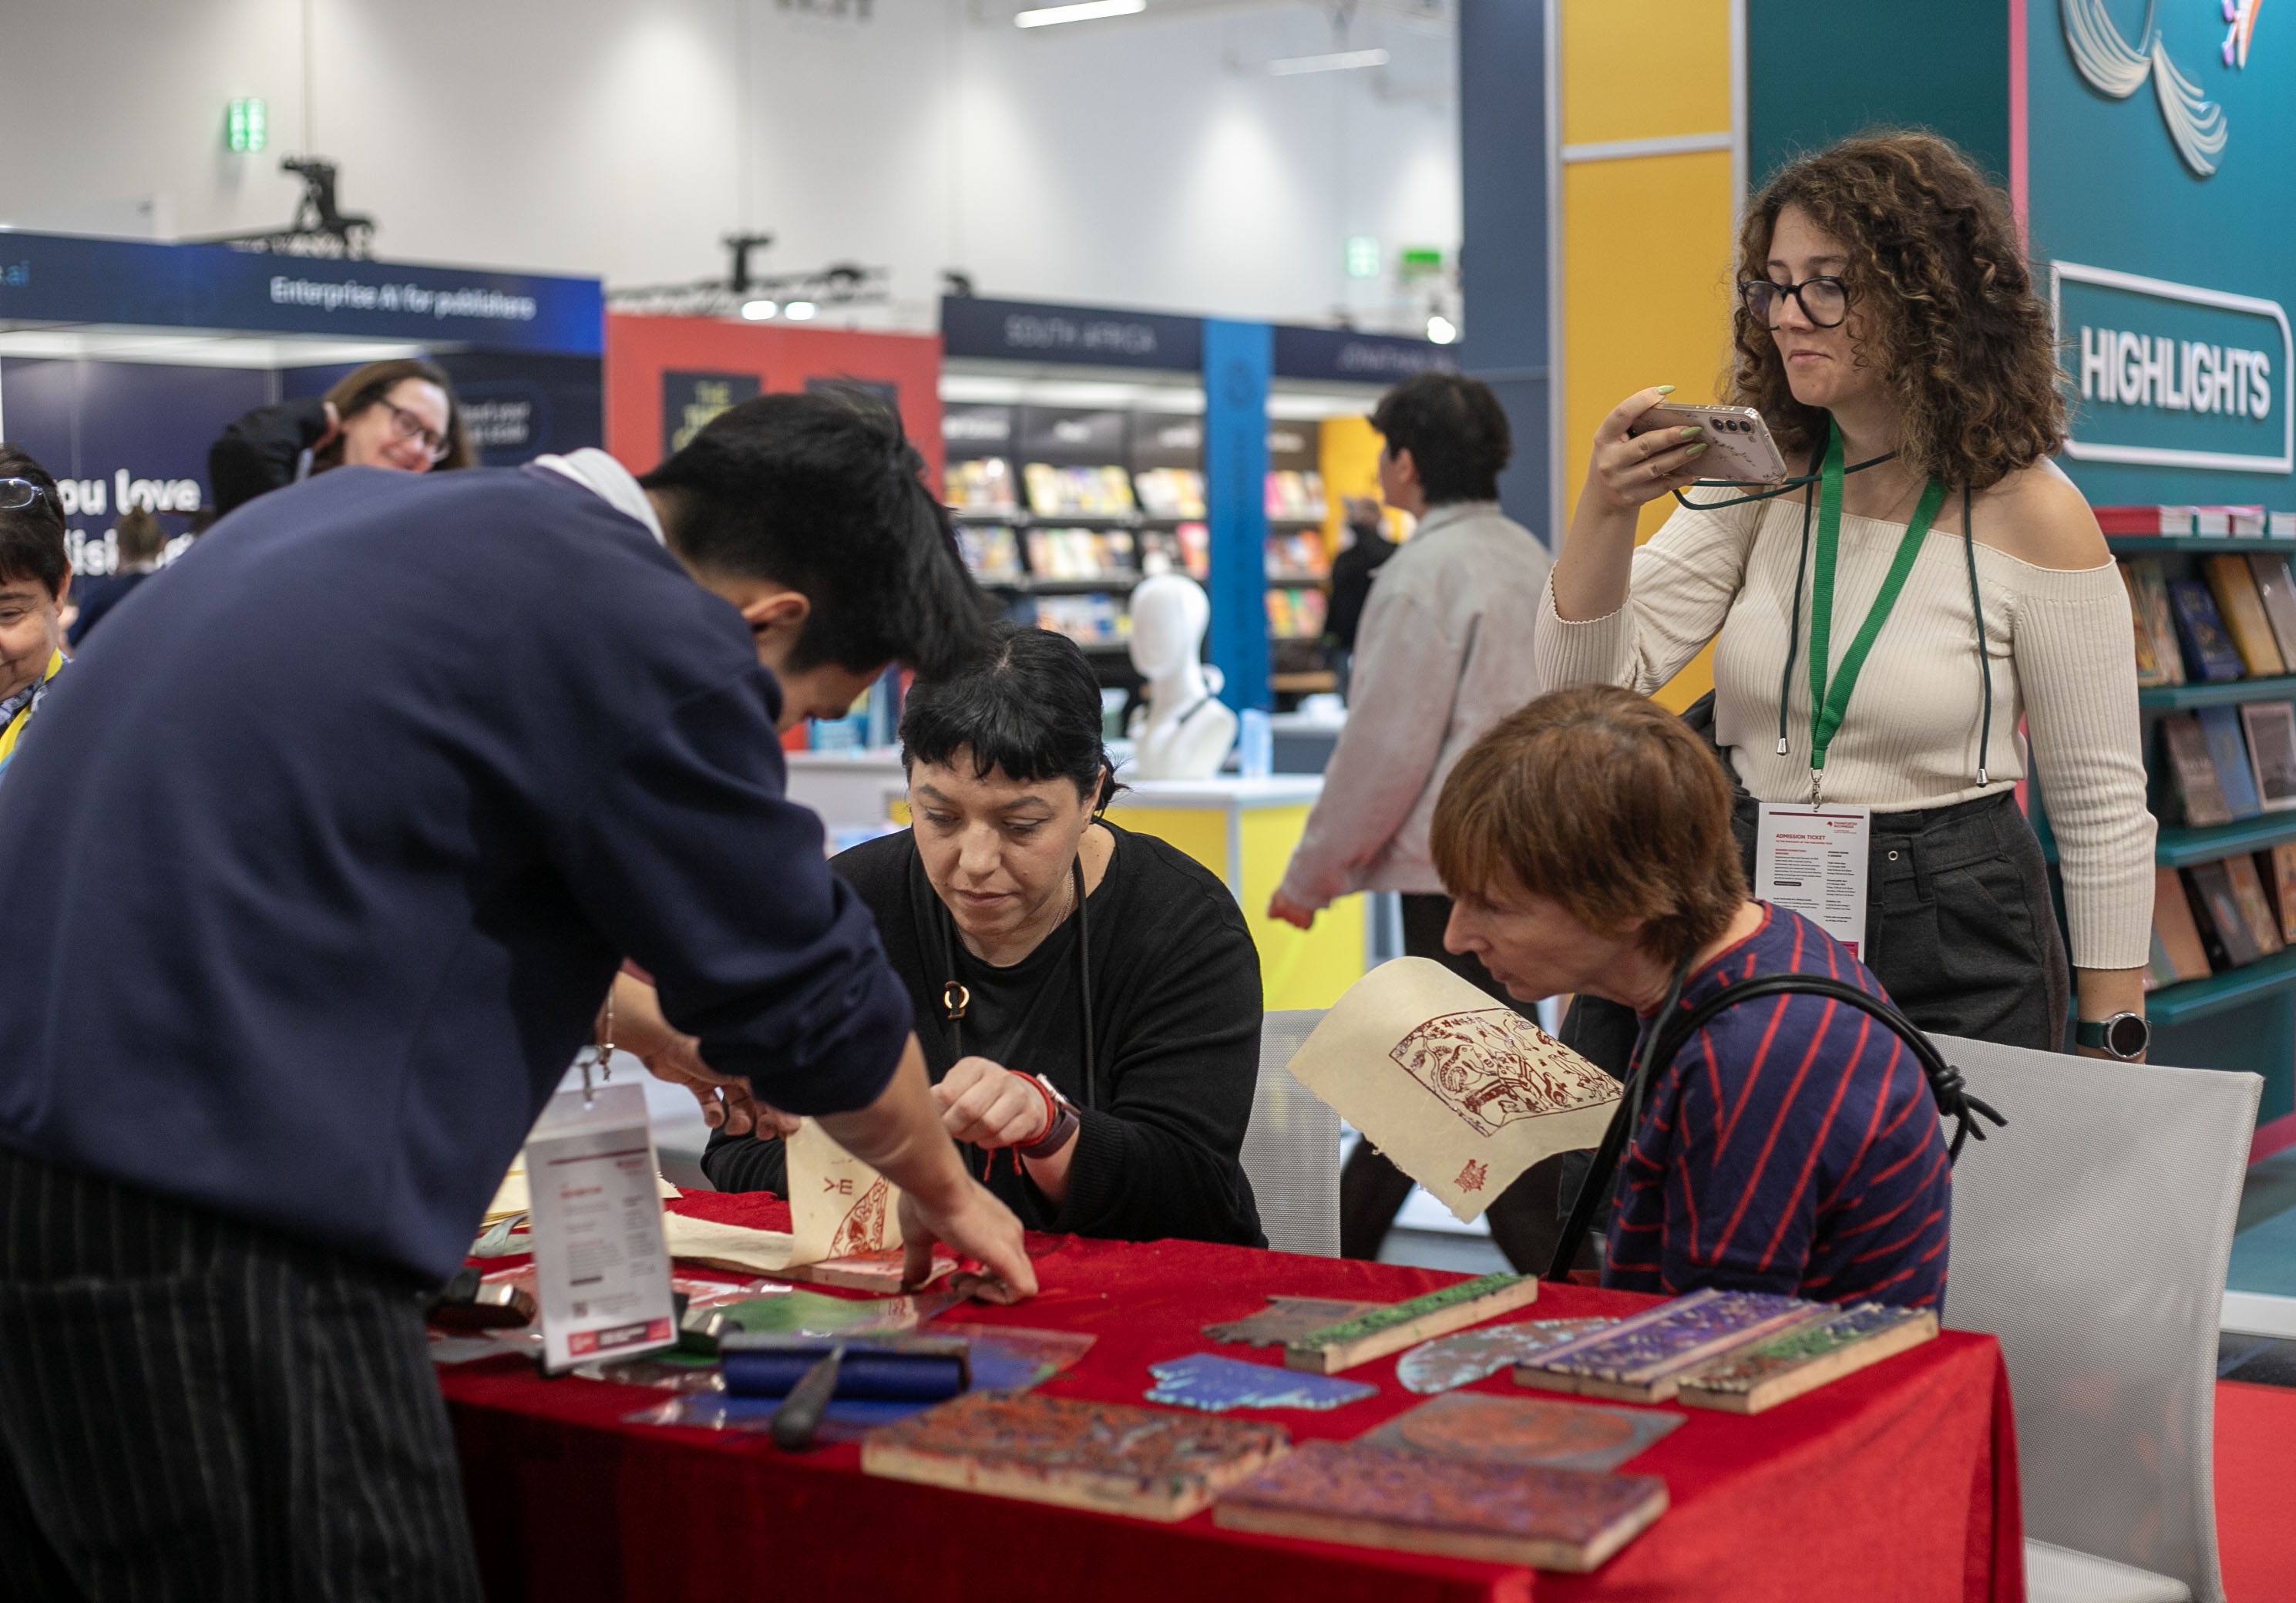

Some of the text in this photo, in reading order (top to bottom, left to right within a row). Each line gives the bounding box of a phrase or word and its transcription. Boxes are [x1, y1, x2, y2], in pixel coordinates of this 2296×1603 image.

[271, 276, 537, 321] Enterprise AI for publishers
[1005, 314, 1077, 348] SOUTH
[2081, 325, 2271, 419] HIGHLIGHTS
[56, 468, 201, 516] ou love
